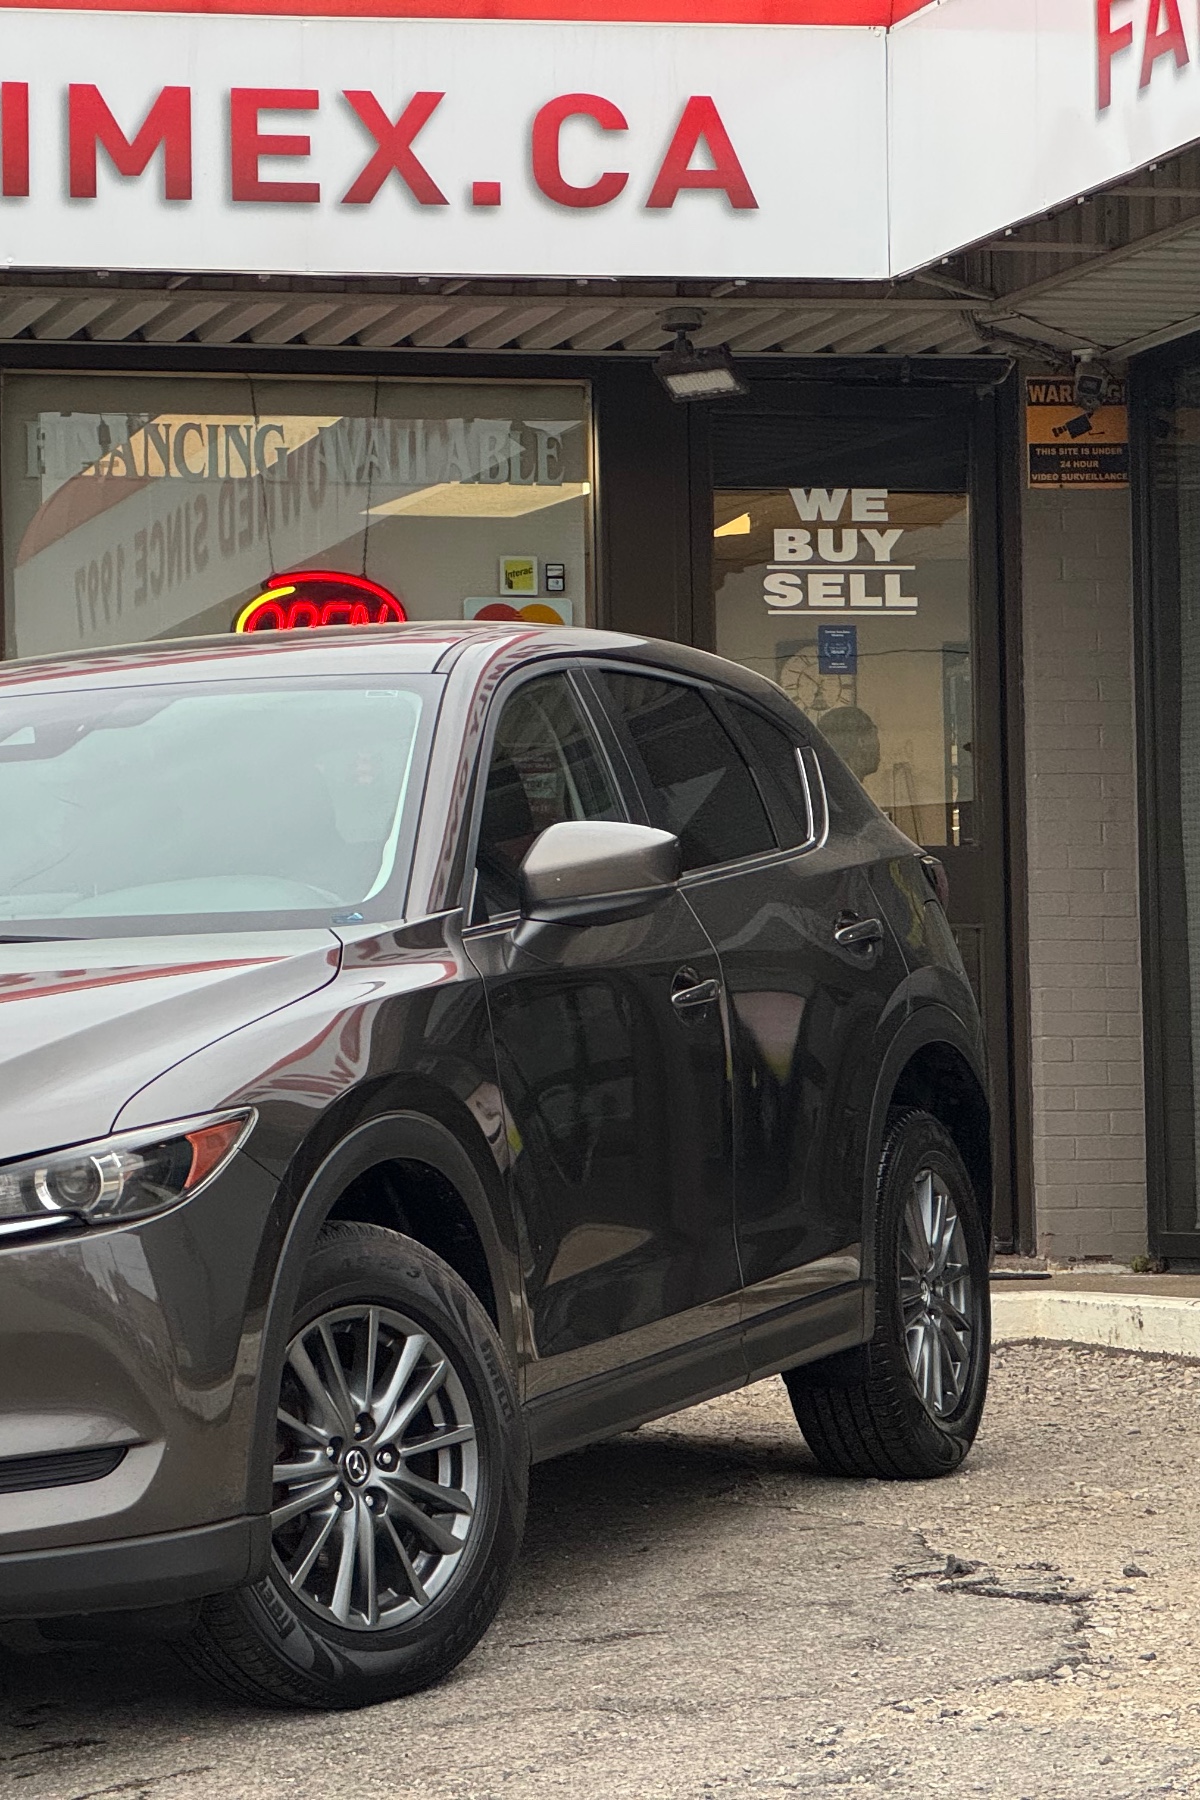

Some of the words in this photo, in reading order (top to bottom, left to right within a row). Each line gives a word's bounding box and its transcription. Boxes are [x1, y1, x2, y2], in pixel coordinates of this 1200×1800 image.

[1097, 0, 1200, 111] FA
[23, 418, 289, 480] FINANCING
[310, 426, 565, 486] AVAILABLE
[1035, 447, 1057, 456] THIS
[1059, 447, 1079, 456] SITE
[1081, 447, 1090, 456] IS
[1091, 447, 1123, 456] UNDER
[1060, 460, 1071, 468] 24
[1073, 460, 1099, 468] HOUR
[1031, 473, 1059, 481] VIDEO
[1061, 472, 1128, 481] SURVEILLANCE
[789, 487, 889, 522] WE
[773, 528, 905, 562] BUY
[763, 573, 918, 608] SELL
